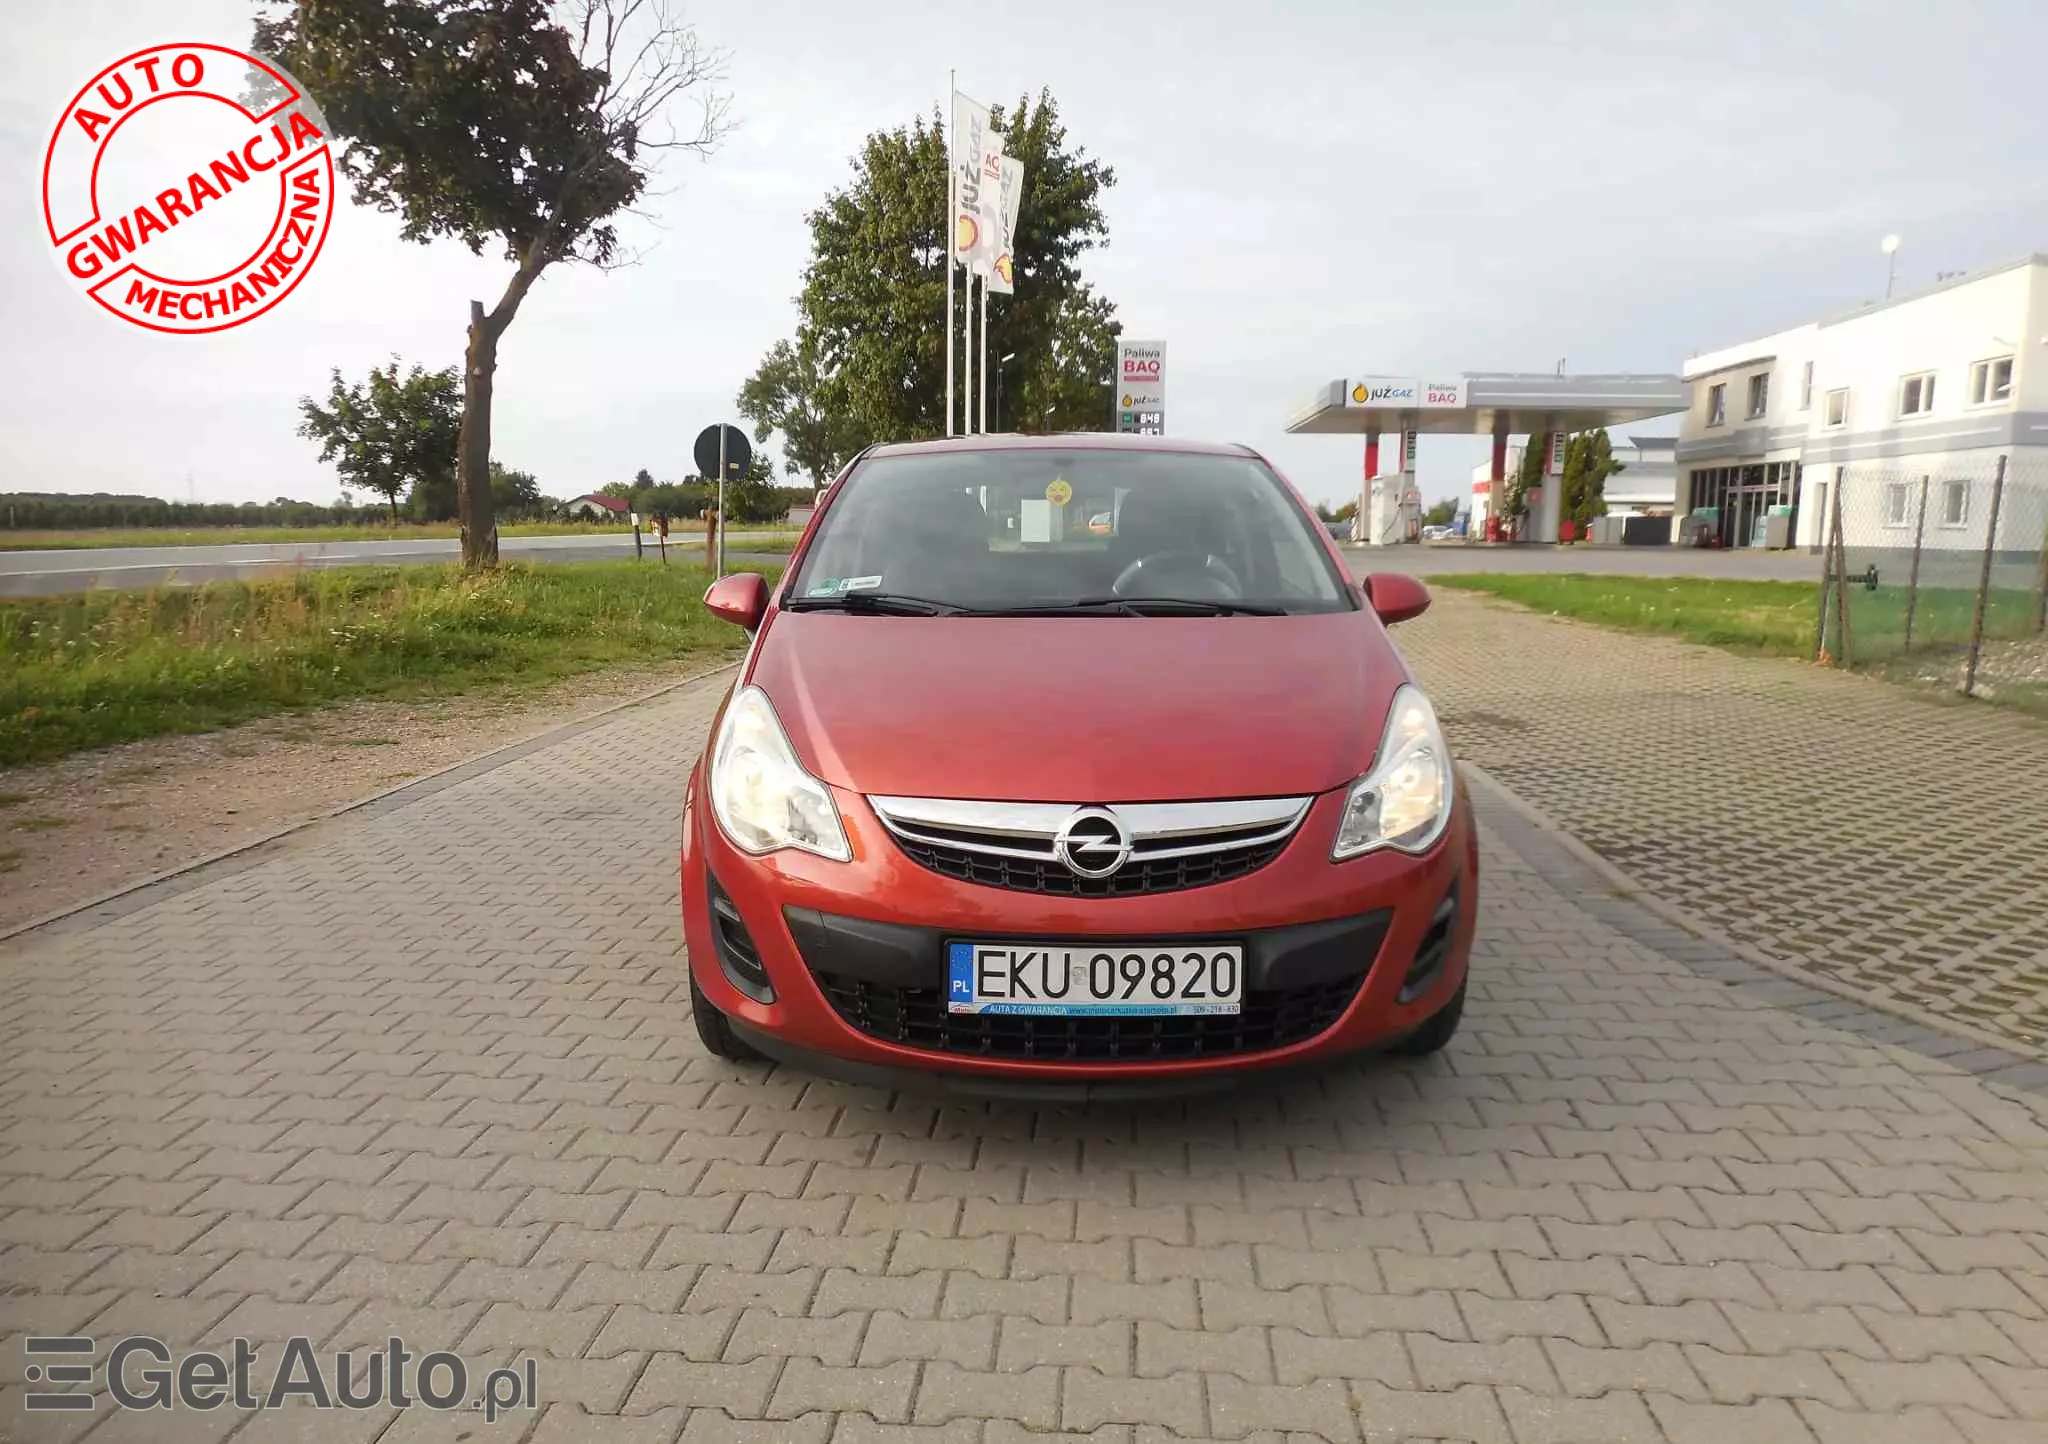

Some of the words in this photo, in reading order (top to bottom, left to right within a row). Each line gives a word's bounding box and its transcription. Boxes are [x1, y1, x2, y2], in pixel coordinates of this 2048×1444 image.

[1124, 347, 1160, 358] Paliwa
[1124, 360, 1160, 374] BAQ
[1428, 392, 1457, 403] BAQ
[978, 950, 1070, 999] EKU
[1089, 952, 1236, 999] 09820
[952, 980, 970, 993] PL
[990, 1004, 1010, 1014] AUTA
[1011, 1004, 1017, 1014] Z
